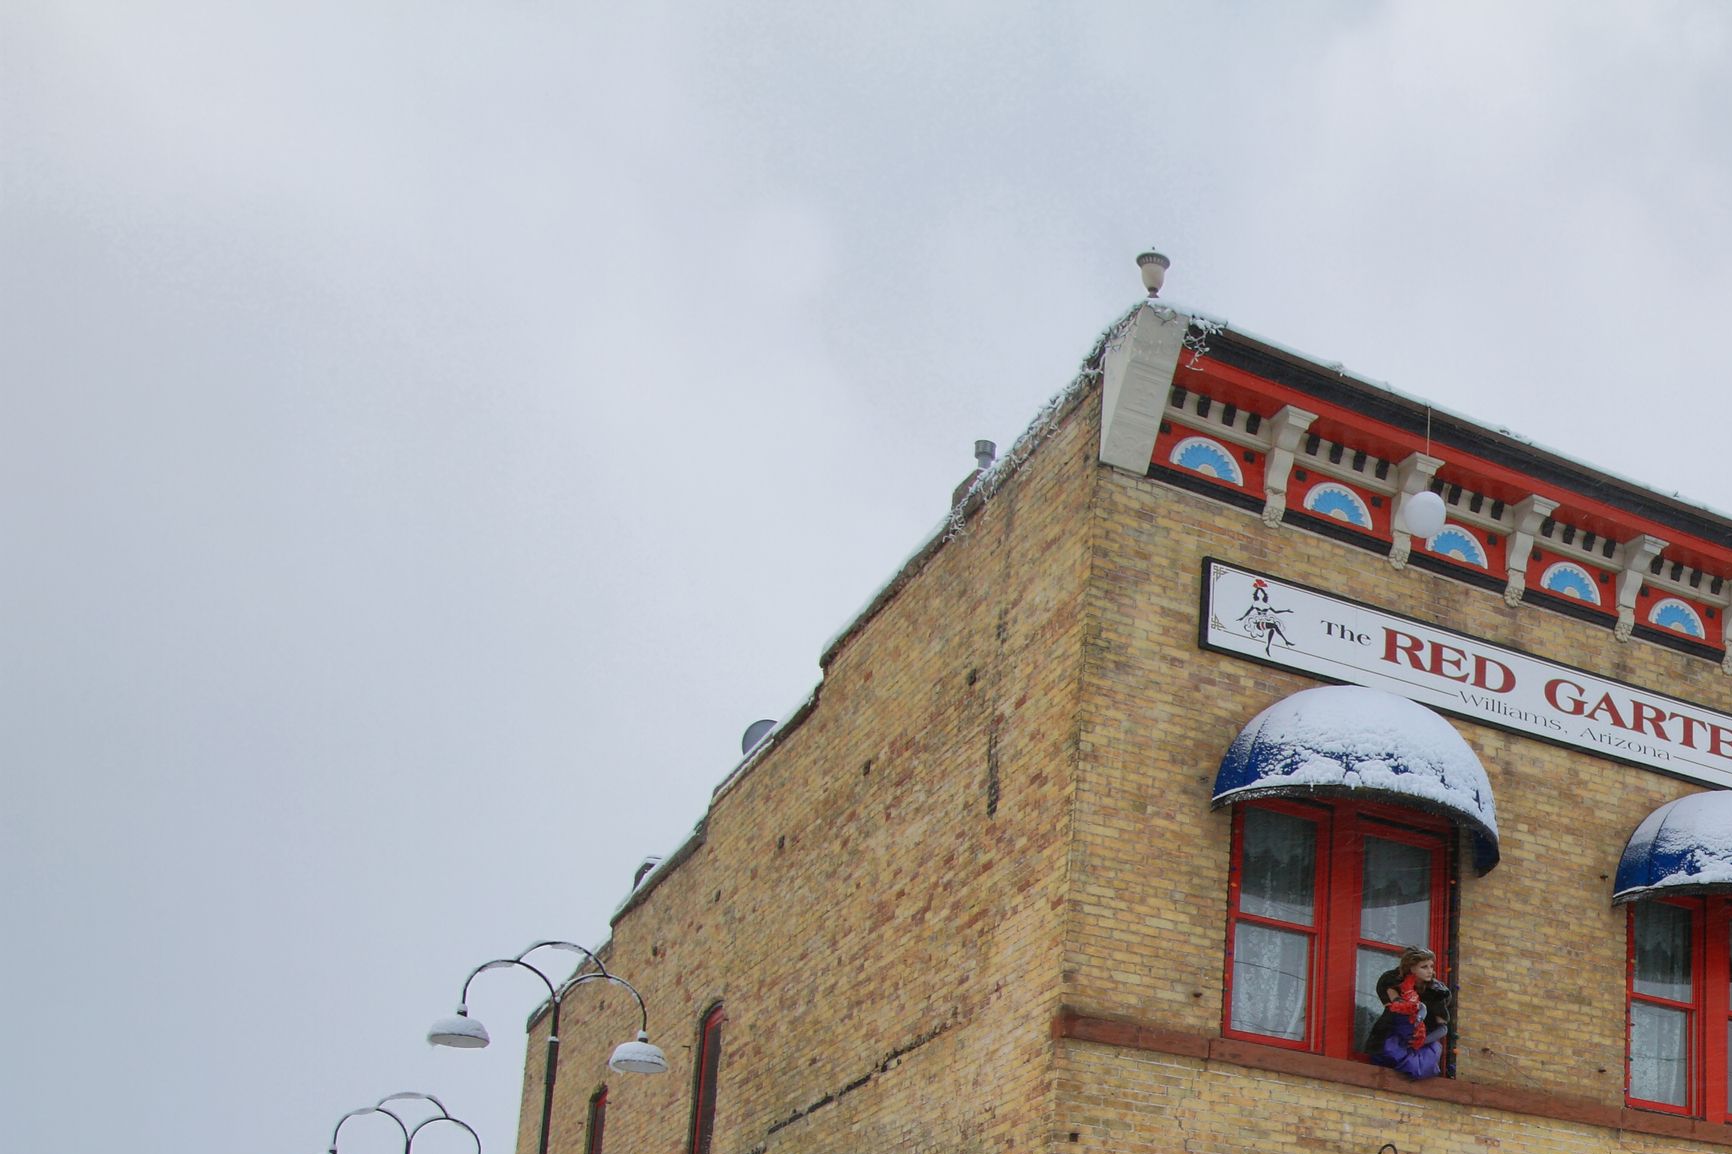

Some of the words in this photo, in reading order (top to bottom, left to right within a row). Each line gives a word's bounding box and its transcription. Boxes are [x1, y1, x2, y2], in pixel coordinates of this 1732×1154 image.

[1320, 620, 1372, 646] The
[1380, 626, 1516, 694] RED
[1458, 690, 1570, 735] Williams,
[1579, 726, 1671, 760] Arizona
